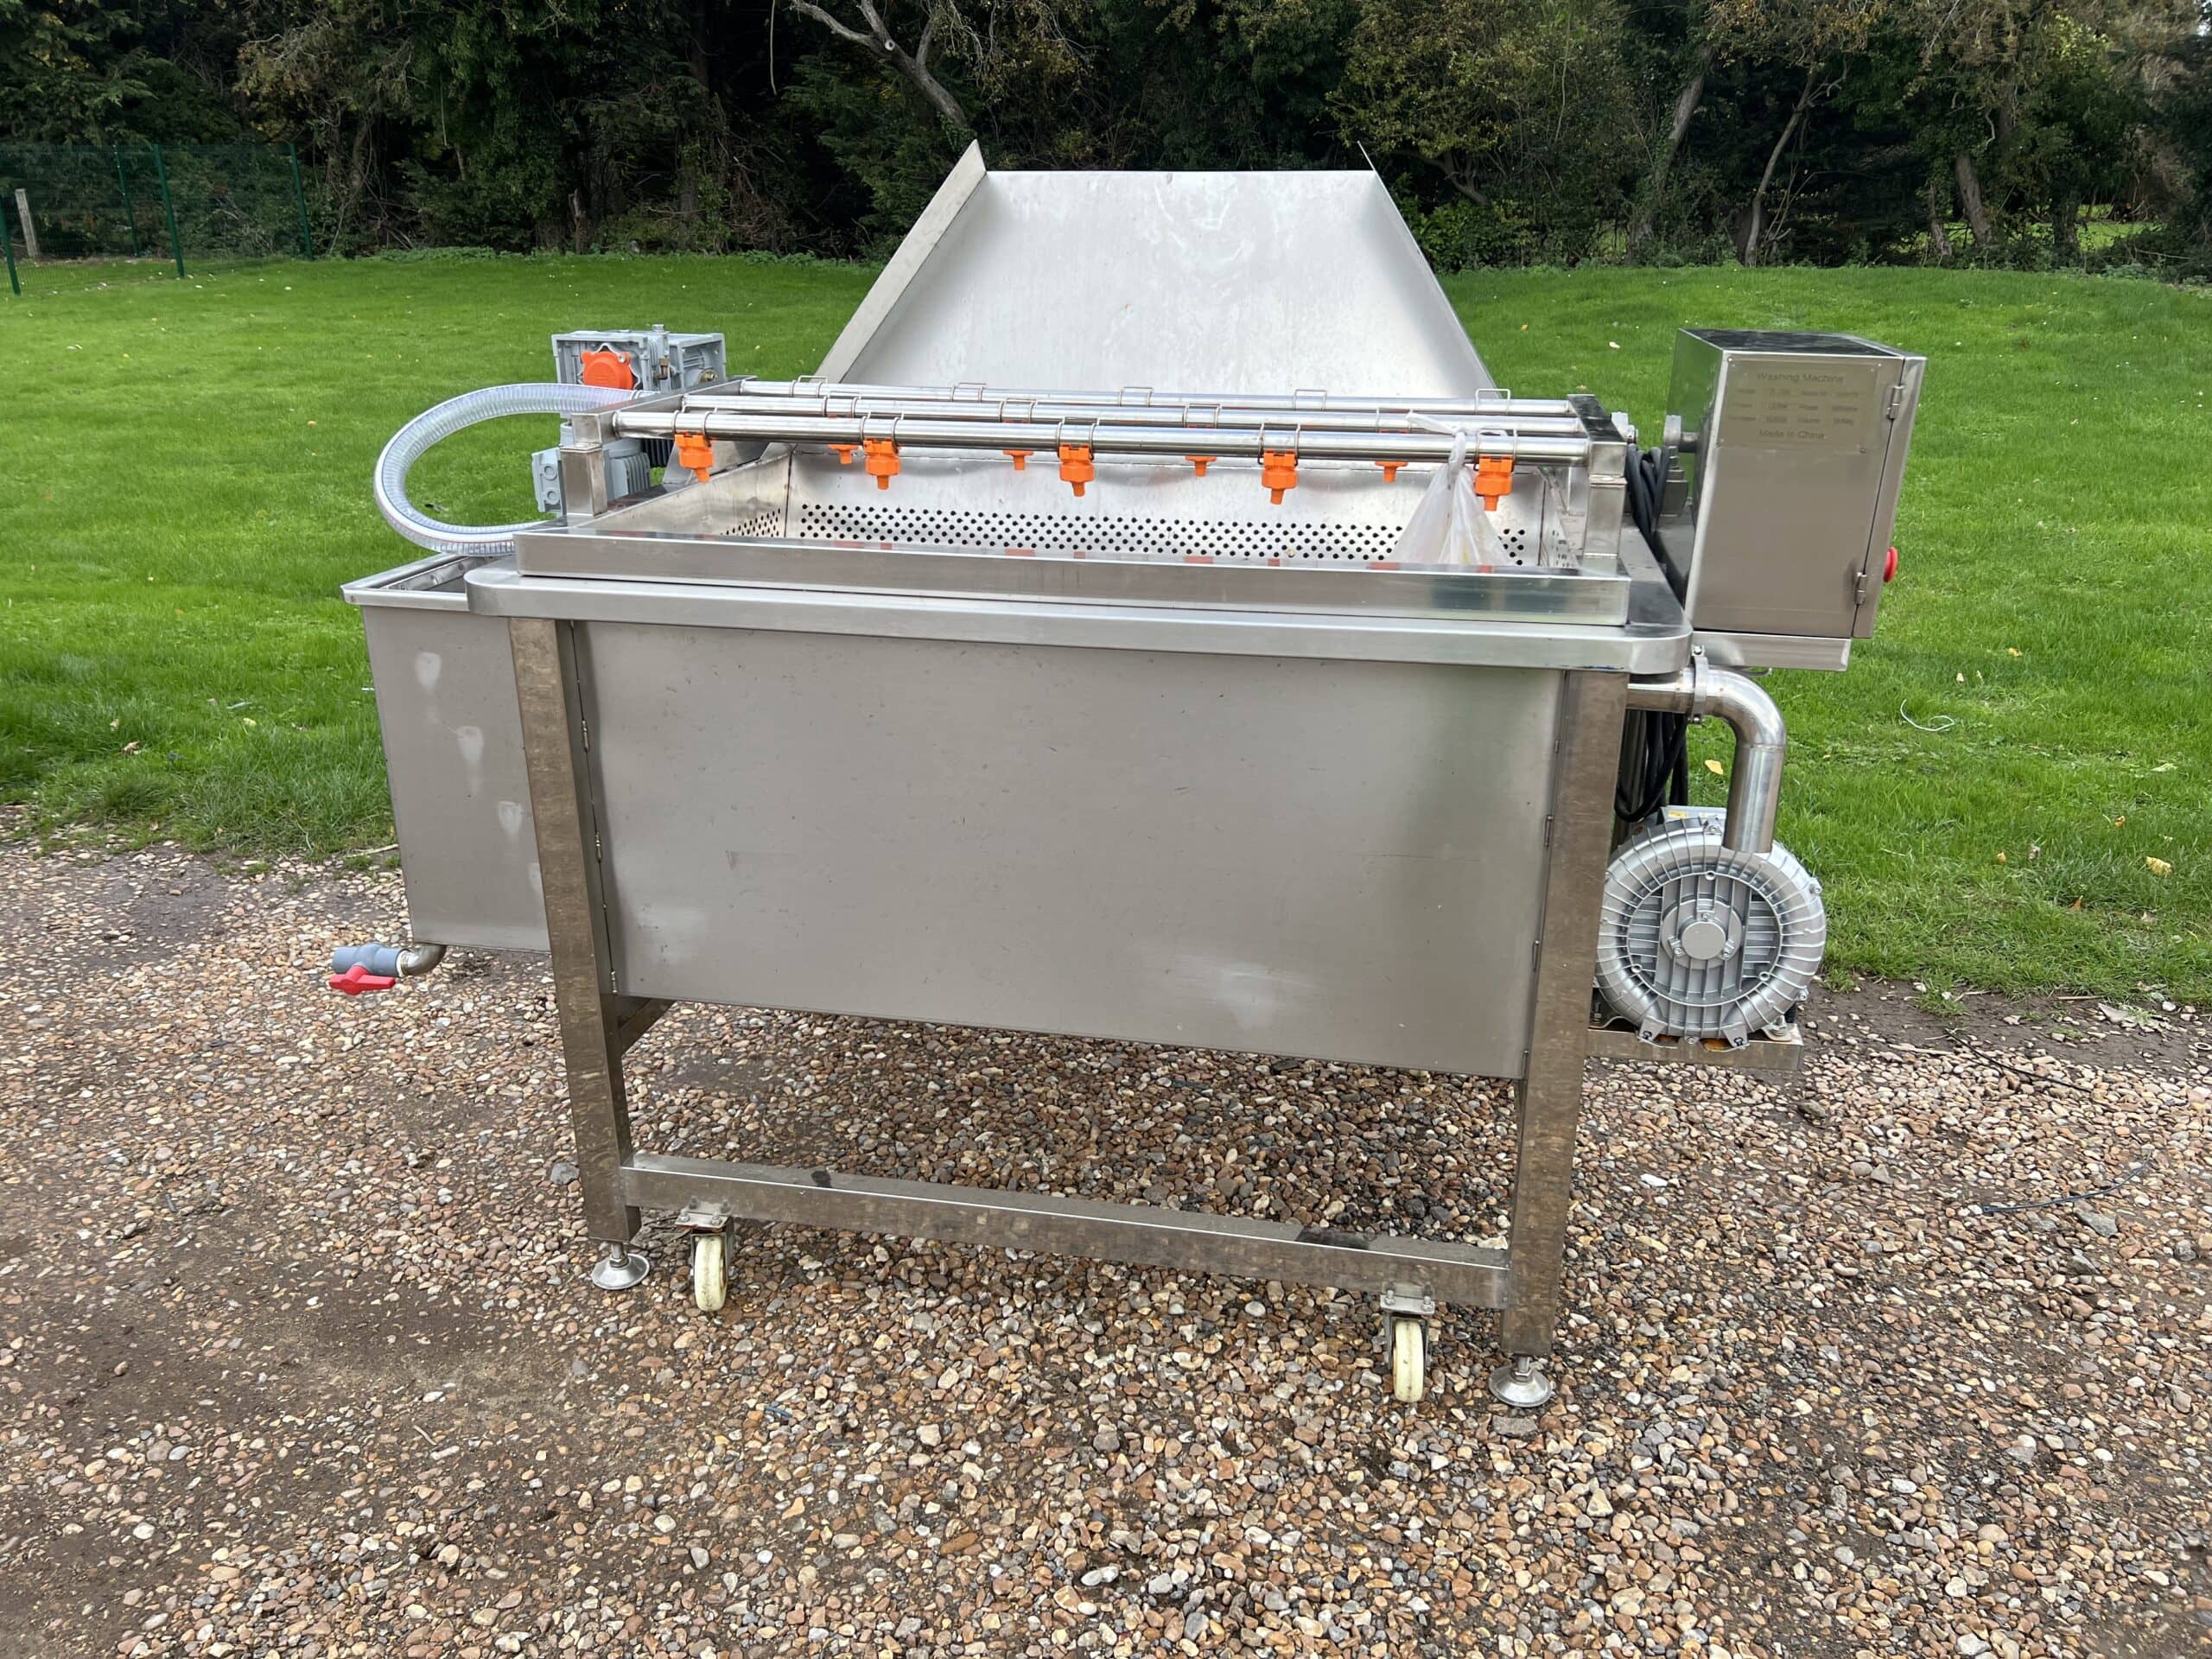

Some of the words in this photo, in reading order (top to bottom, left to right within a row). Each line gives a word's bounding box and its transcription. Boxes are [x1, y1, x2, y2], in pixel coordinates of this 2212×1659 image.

[1758, 372, 1799, 383] Washing
[1803, 373, 1846, 383] Machine
[1758, 429, 1783, 438] Made
[1797, 430, 1825, 440] China
